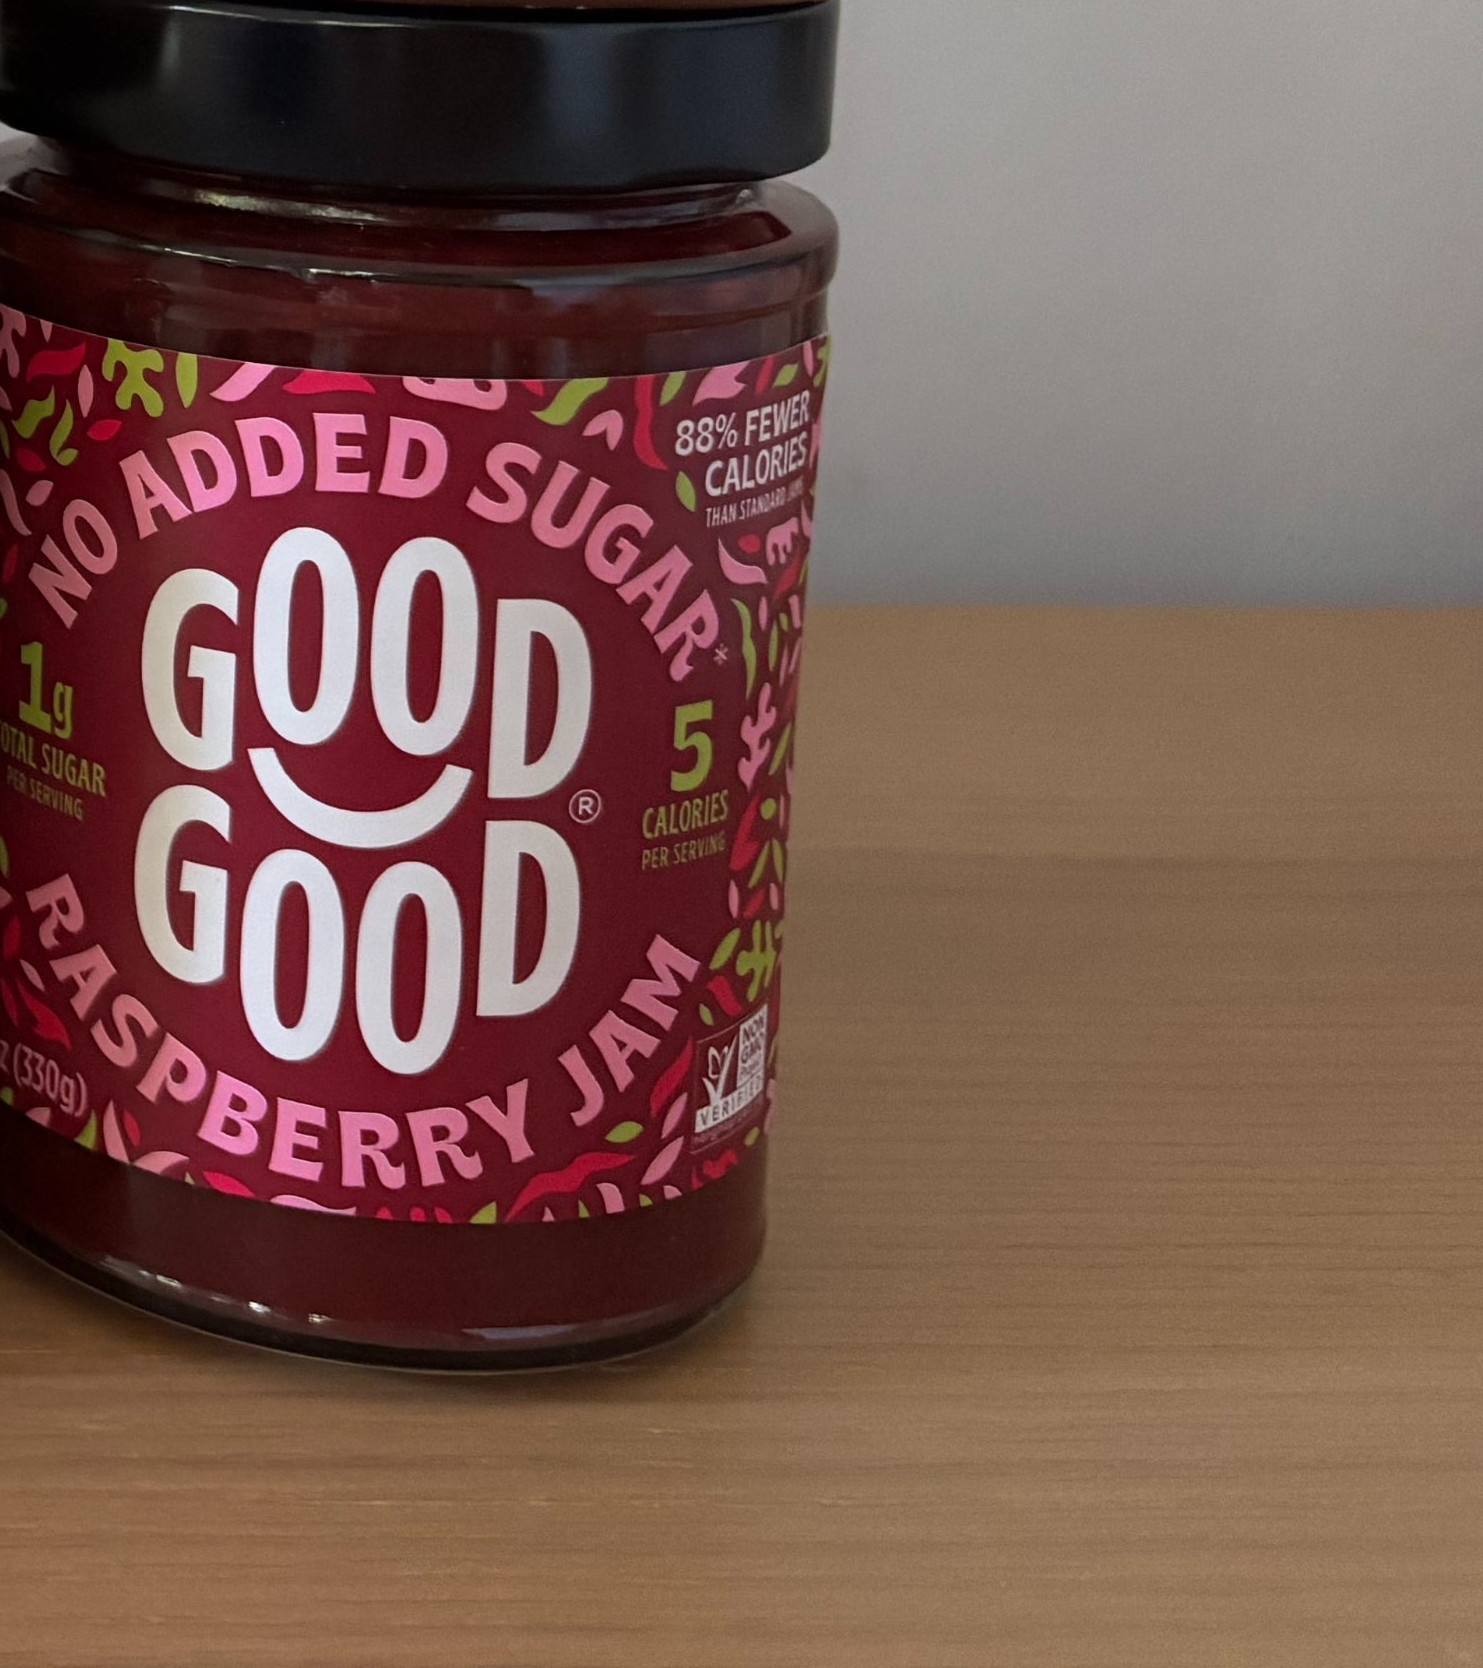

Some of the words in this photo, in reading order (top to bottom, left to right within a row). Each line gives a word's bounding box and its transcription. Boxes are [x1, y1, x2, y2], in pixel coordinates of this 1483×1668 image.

[675, 412, 738, 456] 88%
[745, 390, 810, 446] FEWER
[705, 431, 808, 497] CALORIES
[18, 641, 73, 739] 1g
[141, 526, 592, 799] GOOD
[42, 742, 106, 798] SUGAR
[670, 699, 713, 792] 5
[642, 789, 729, 840] CALORIES
[642, 846, 669, 871] PER
[673, 830, 725, 864] SERVING
[134, 784, 581, 1075] GOOD
[25, 873, 535, 1190] RASPBERRY
[558, 933, 701, 1127] JAM
